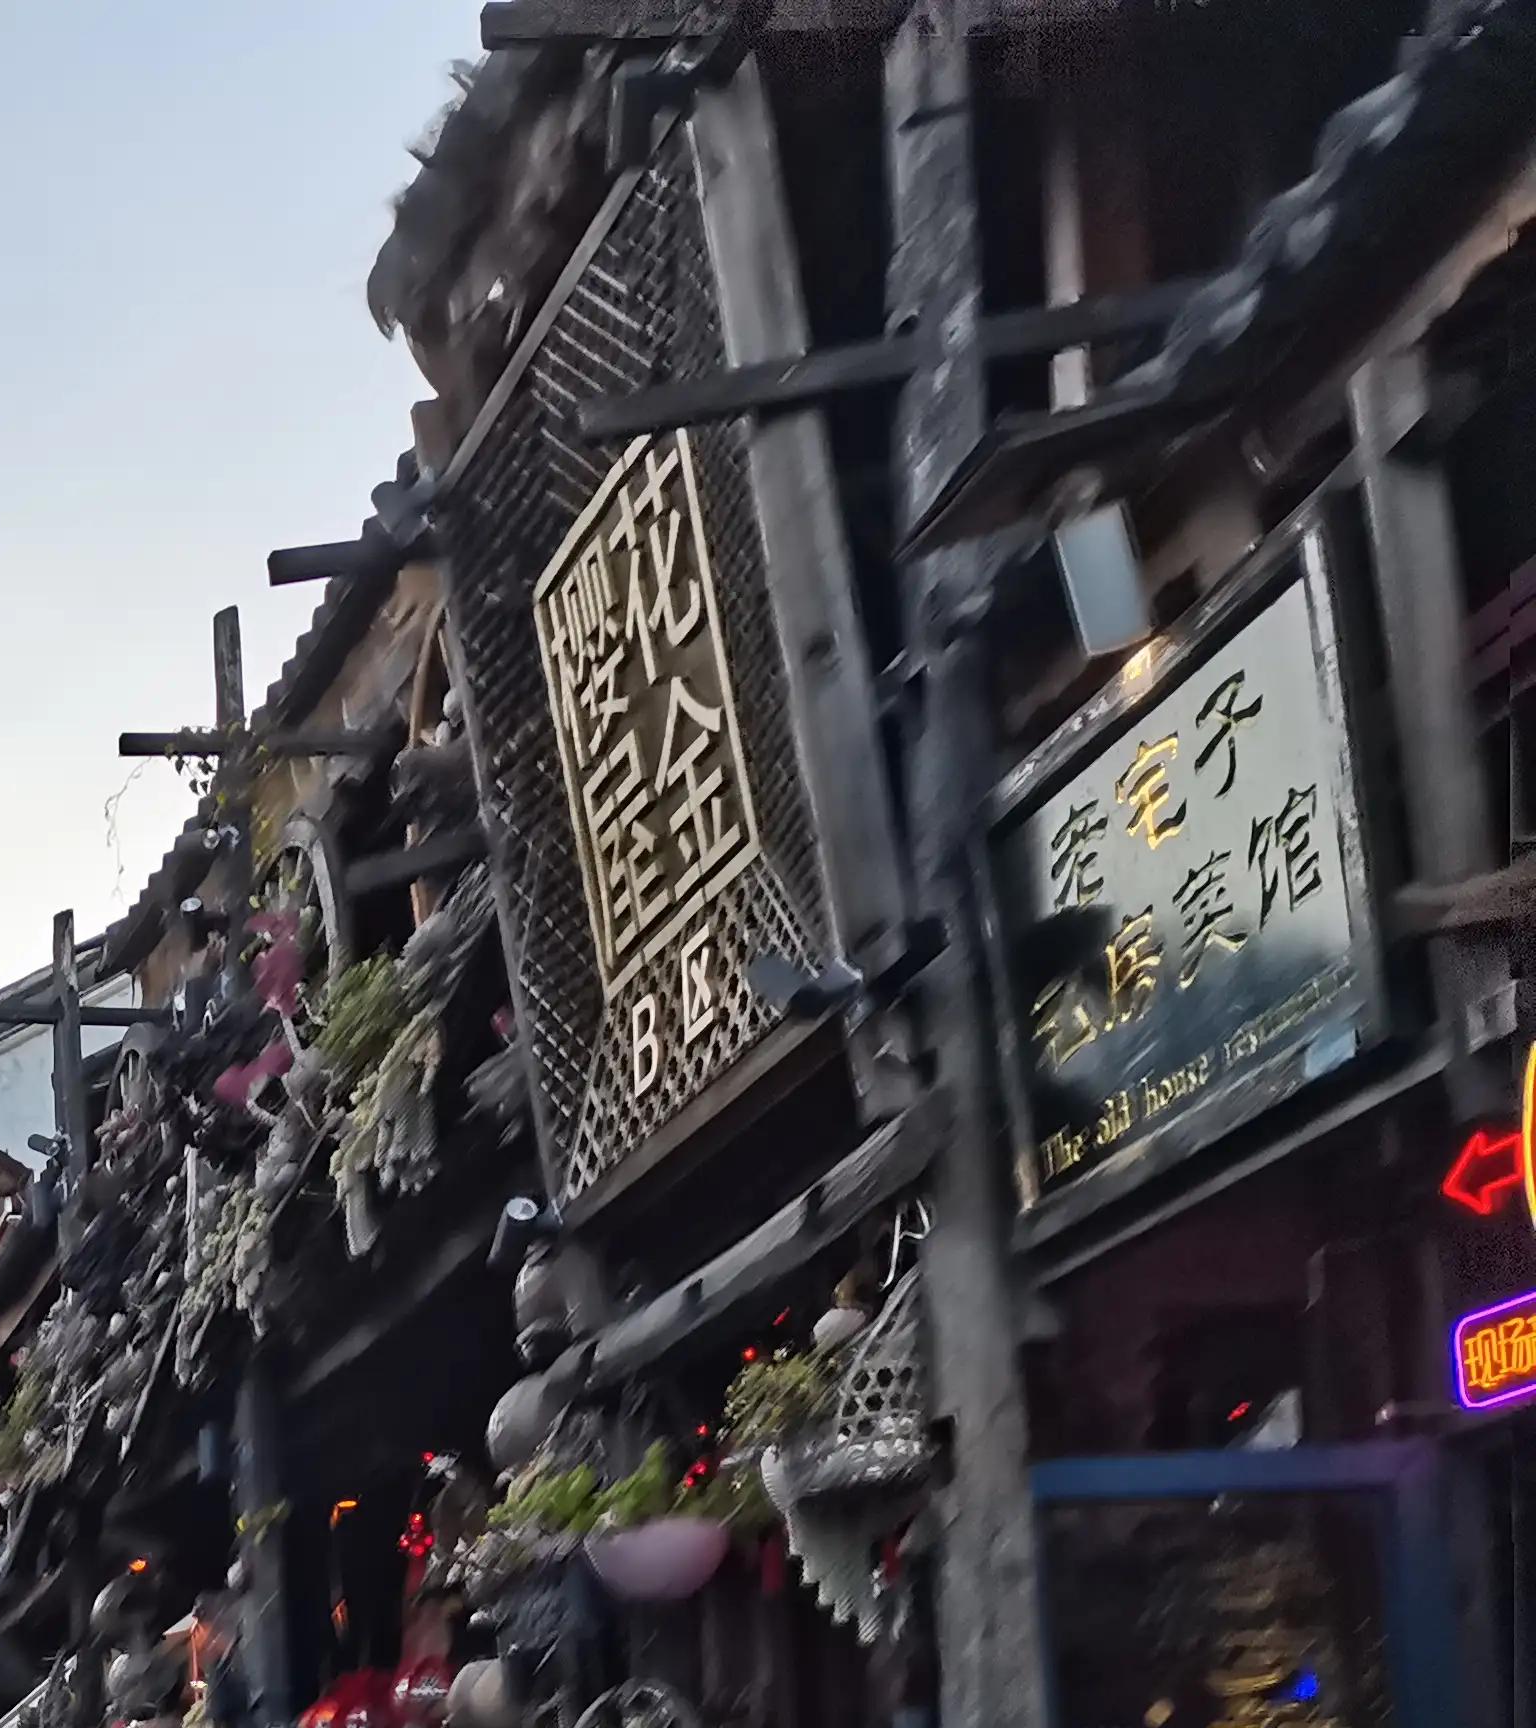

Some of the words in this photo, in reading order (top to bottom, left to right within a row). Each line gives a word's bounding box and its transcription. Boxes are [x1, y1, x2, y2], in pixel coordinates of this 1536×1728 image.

[582, 678, 741, 970] 屋金
[1051, 668, 1264, 912] 老宅子
[632, 923, 715, 1099] B区
[1039, 1126, 1090, 1183] The
[1141, 1053, 1212, 1121] house
[1463, 1315, 1536, 1388] 现场
